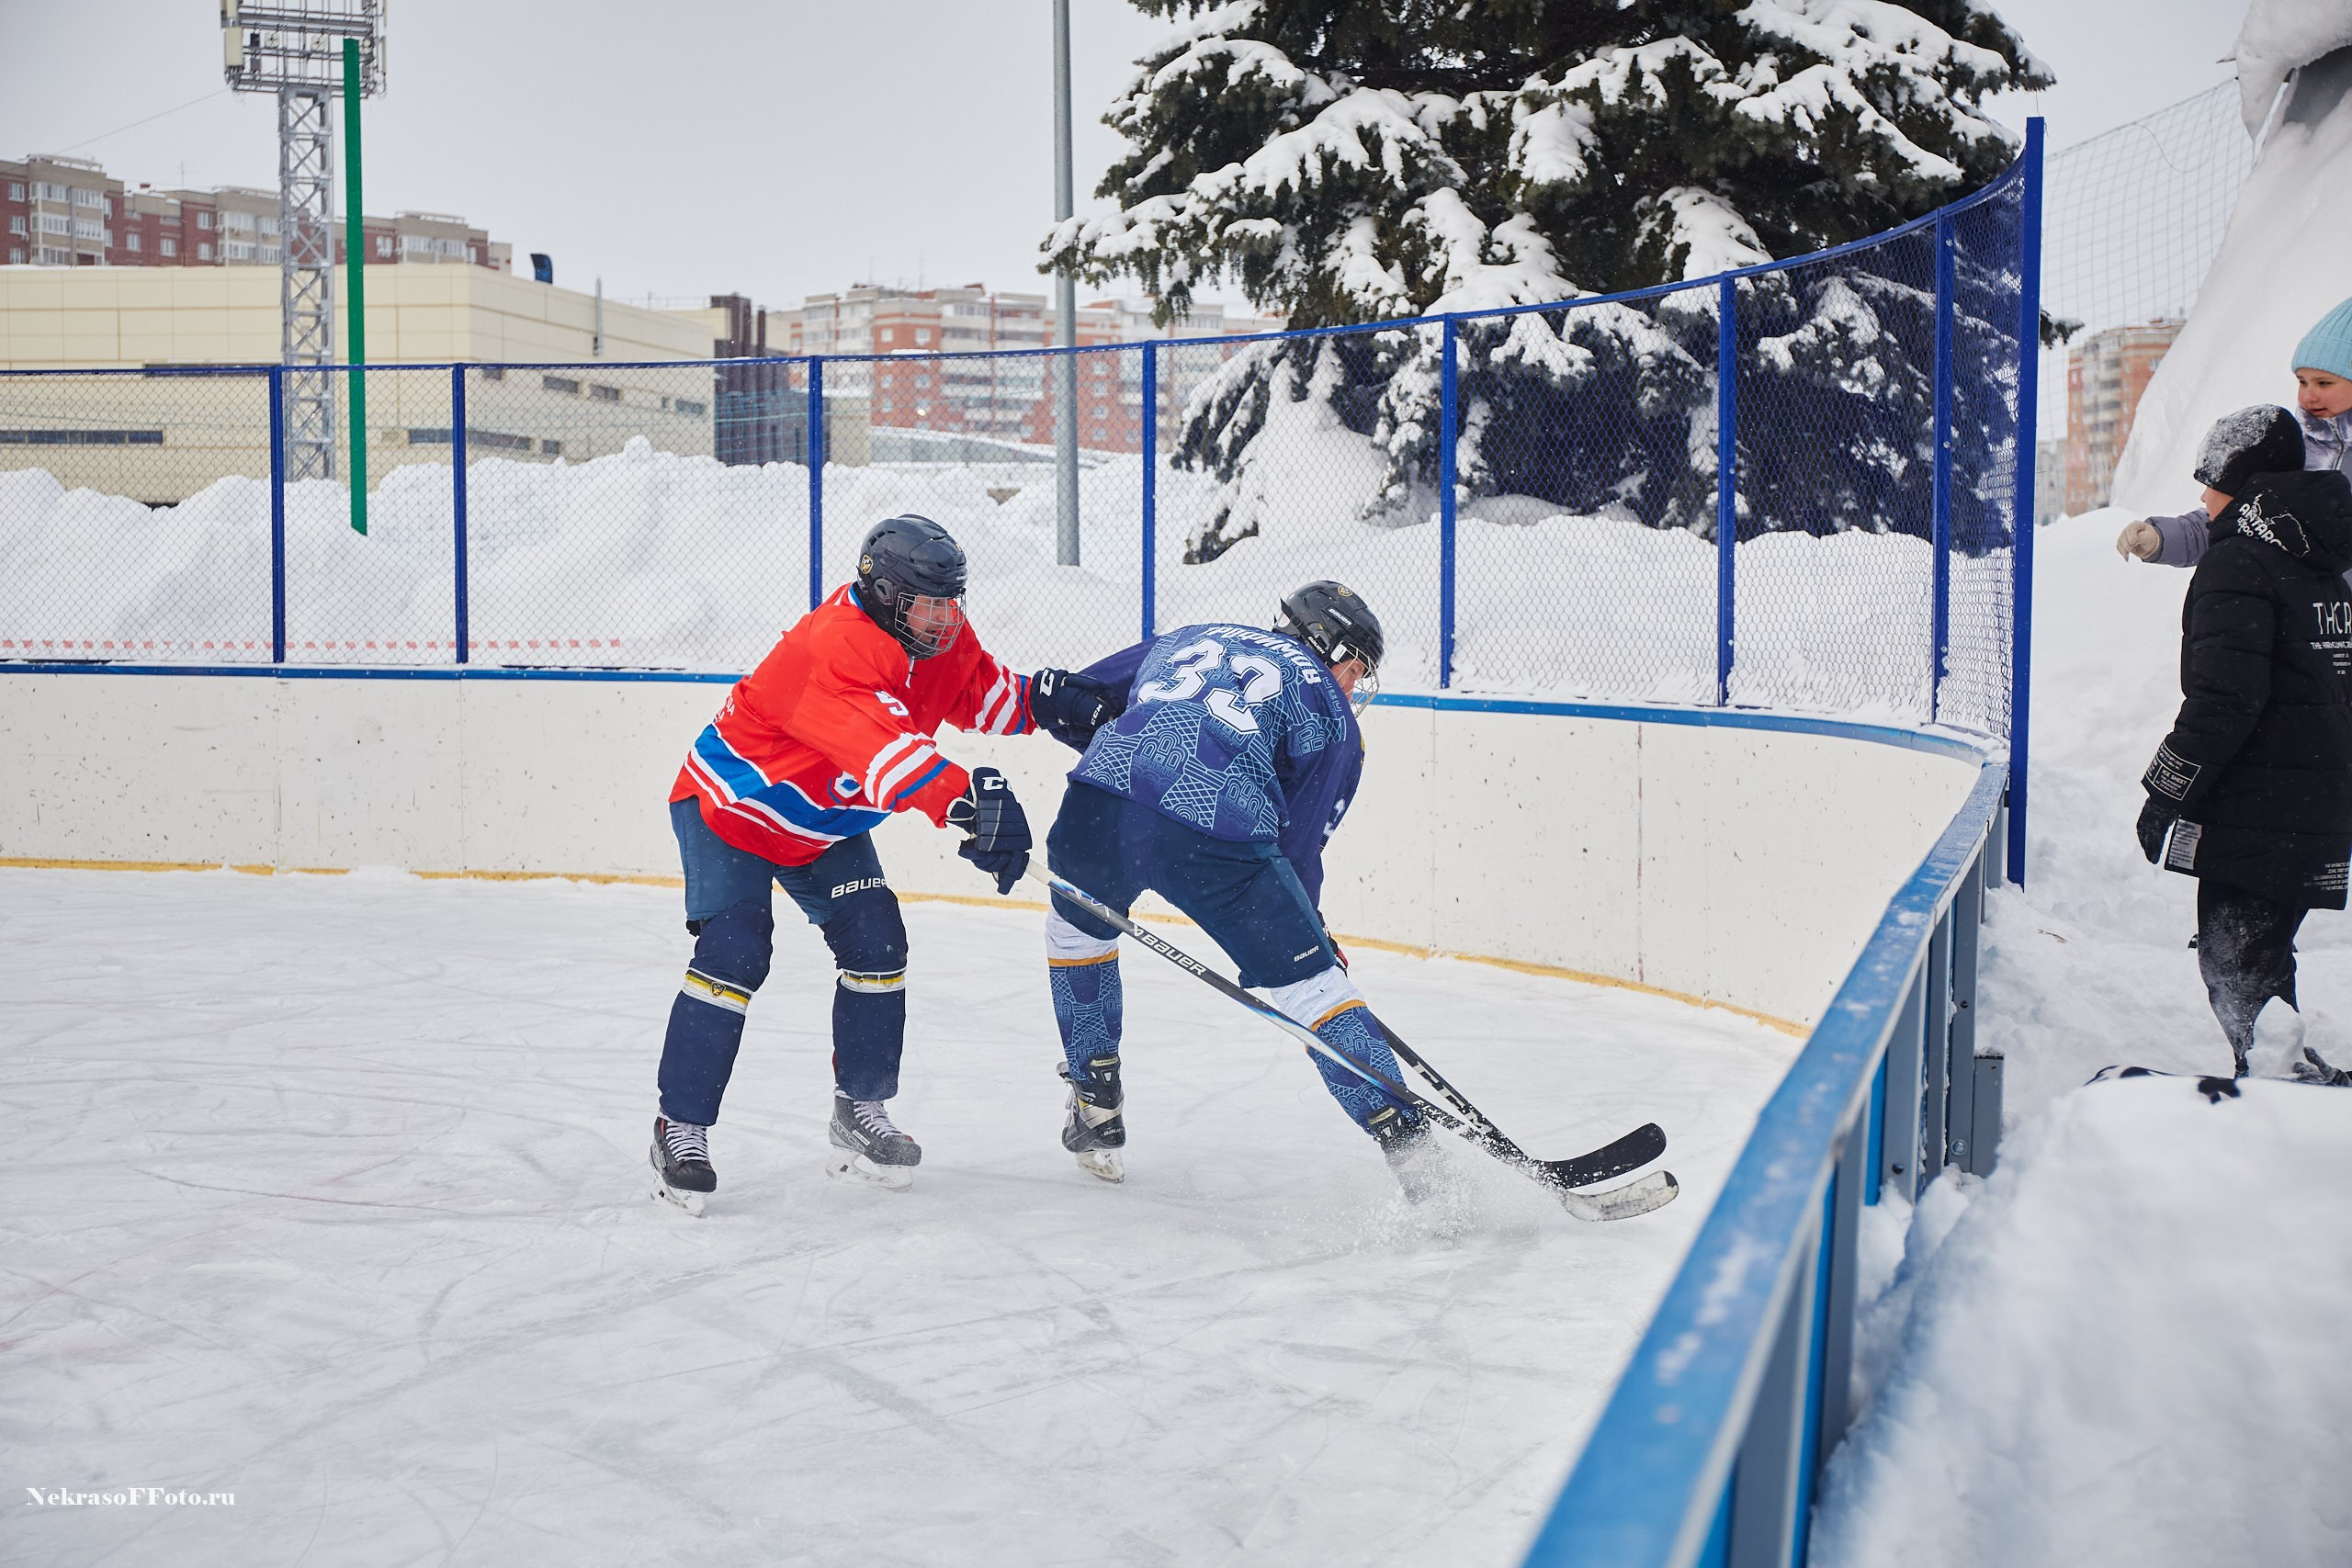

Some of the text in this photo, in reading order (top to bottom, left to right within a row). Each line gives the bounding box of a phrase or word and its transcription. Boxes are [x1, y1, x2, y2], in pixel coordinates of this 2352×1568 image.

[1137, 639, 1283, 735] 33
[1091, 704, 1103, 727] CCM
[1141, 935, 1206, 976] BAUER
[1294, 945, 1319, 962] BAUER
